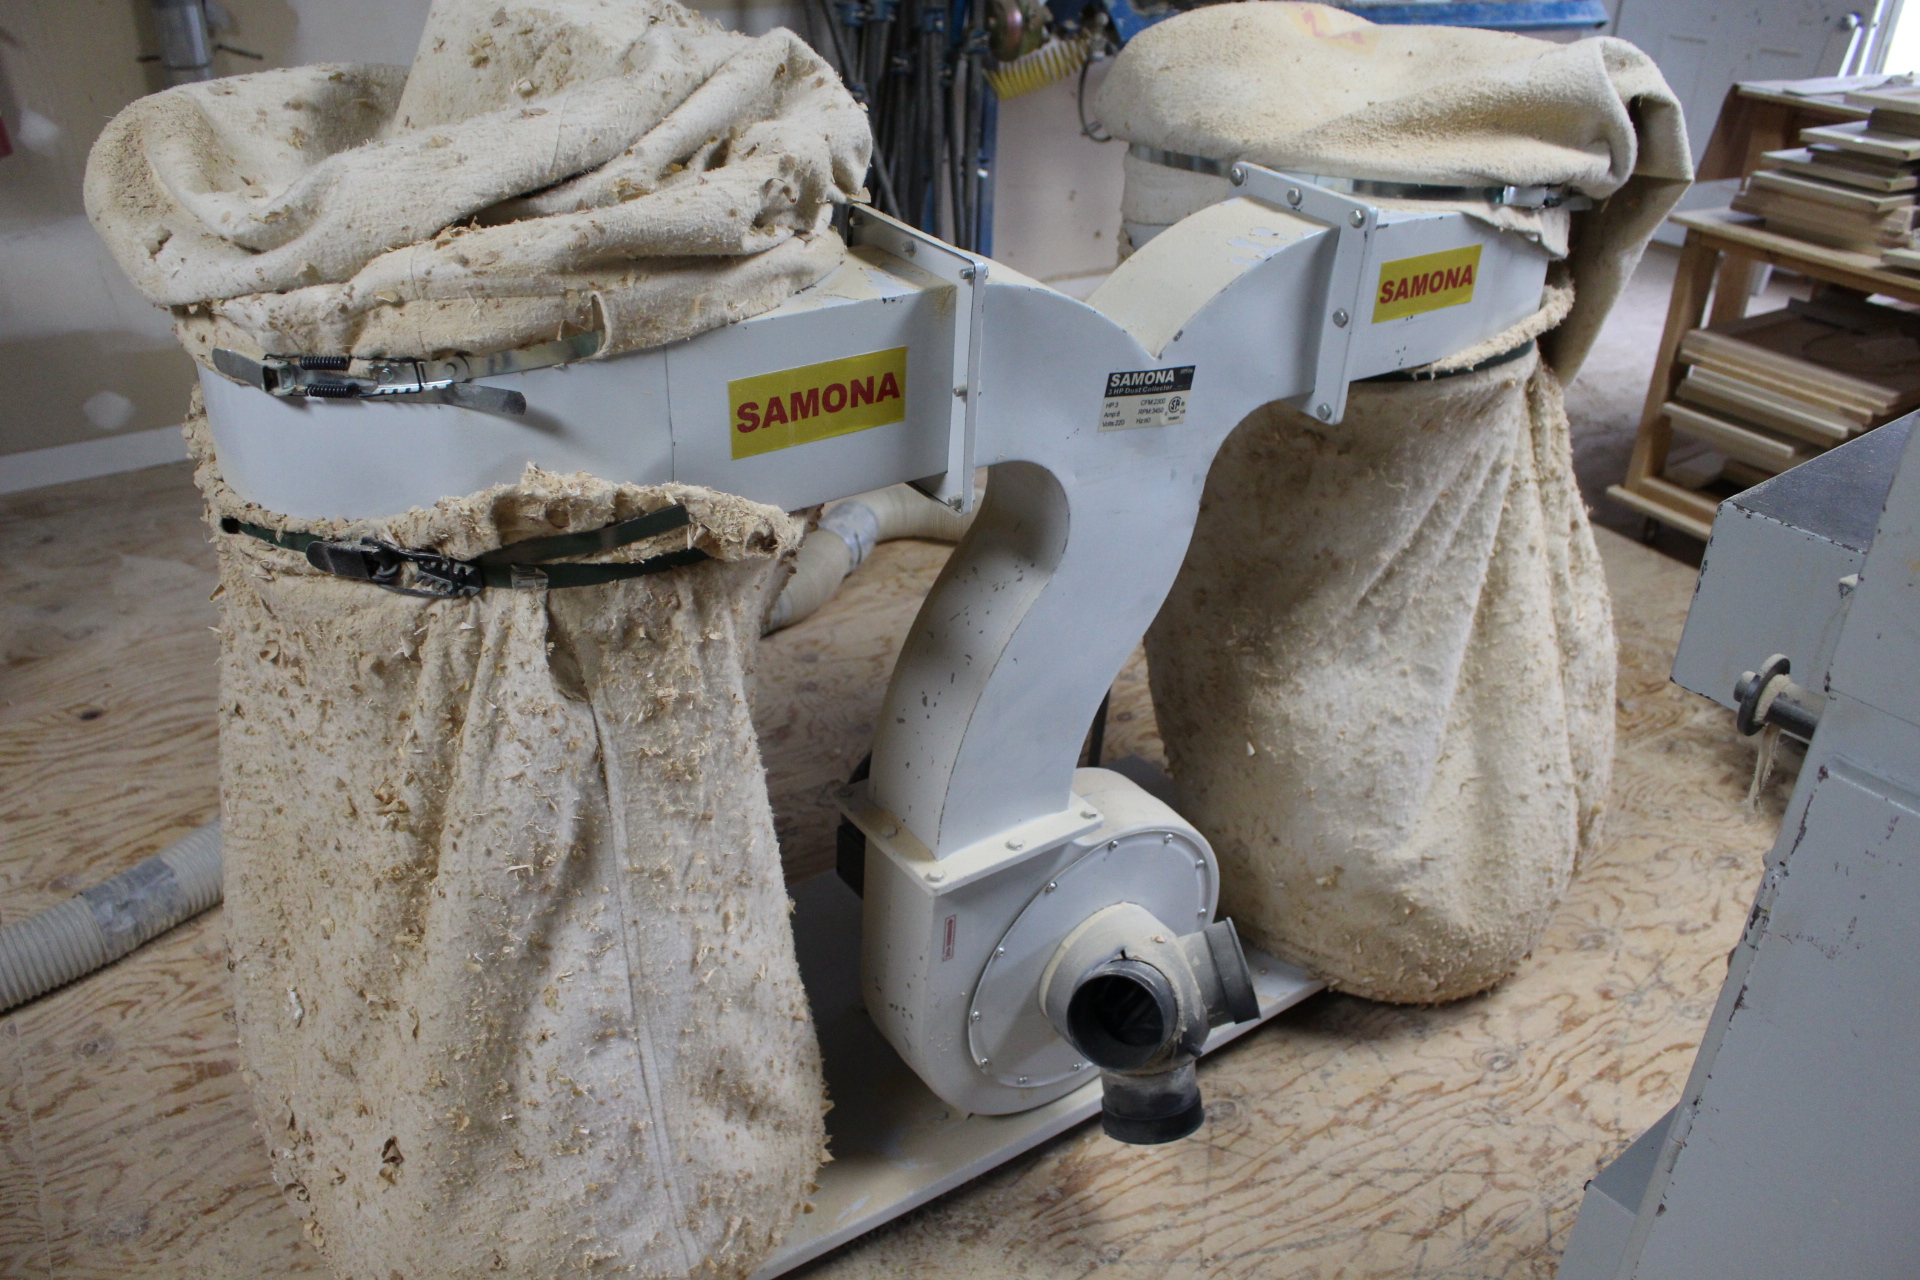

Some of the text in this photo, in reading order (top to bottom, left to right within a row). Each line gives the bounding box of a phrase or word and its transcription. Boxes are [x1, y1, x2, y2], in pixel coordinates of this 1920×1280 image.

[1379, 264, 1473, 304] SAMONA
[1110, 370, 1174, 386] SAMONA
[1125, 386, 1141, 394] Dust
[1142, 384, 1173, 393] Collector
[736, 371, 901, 434] SAMONA
